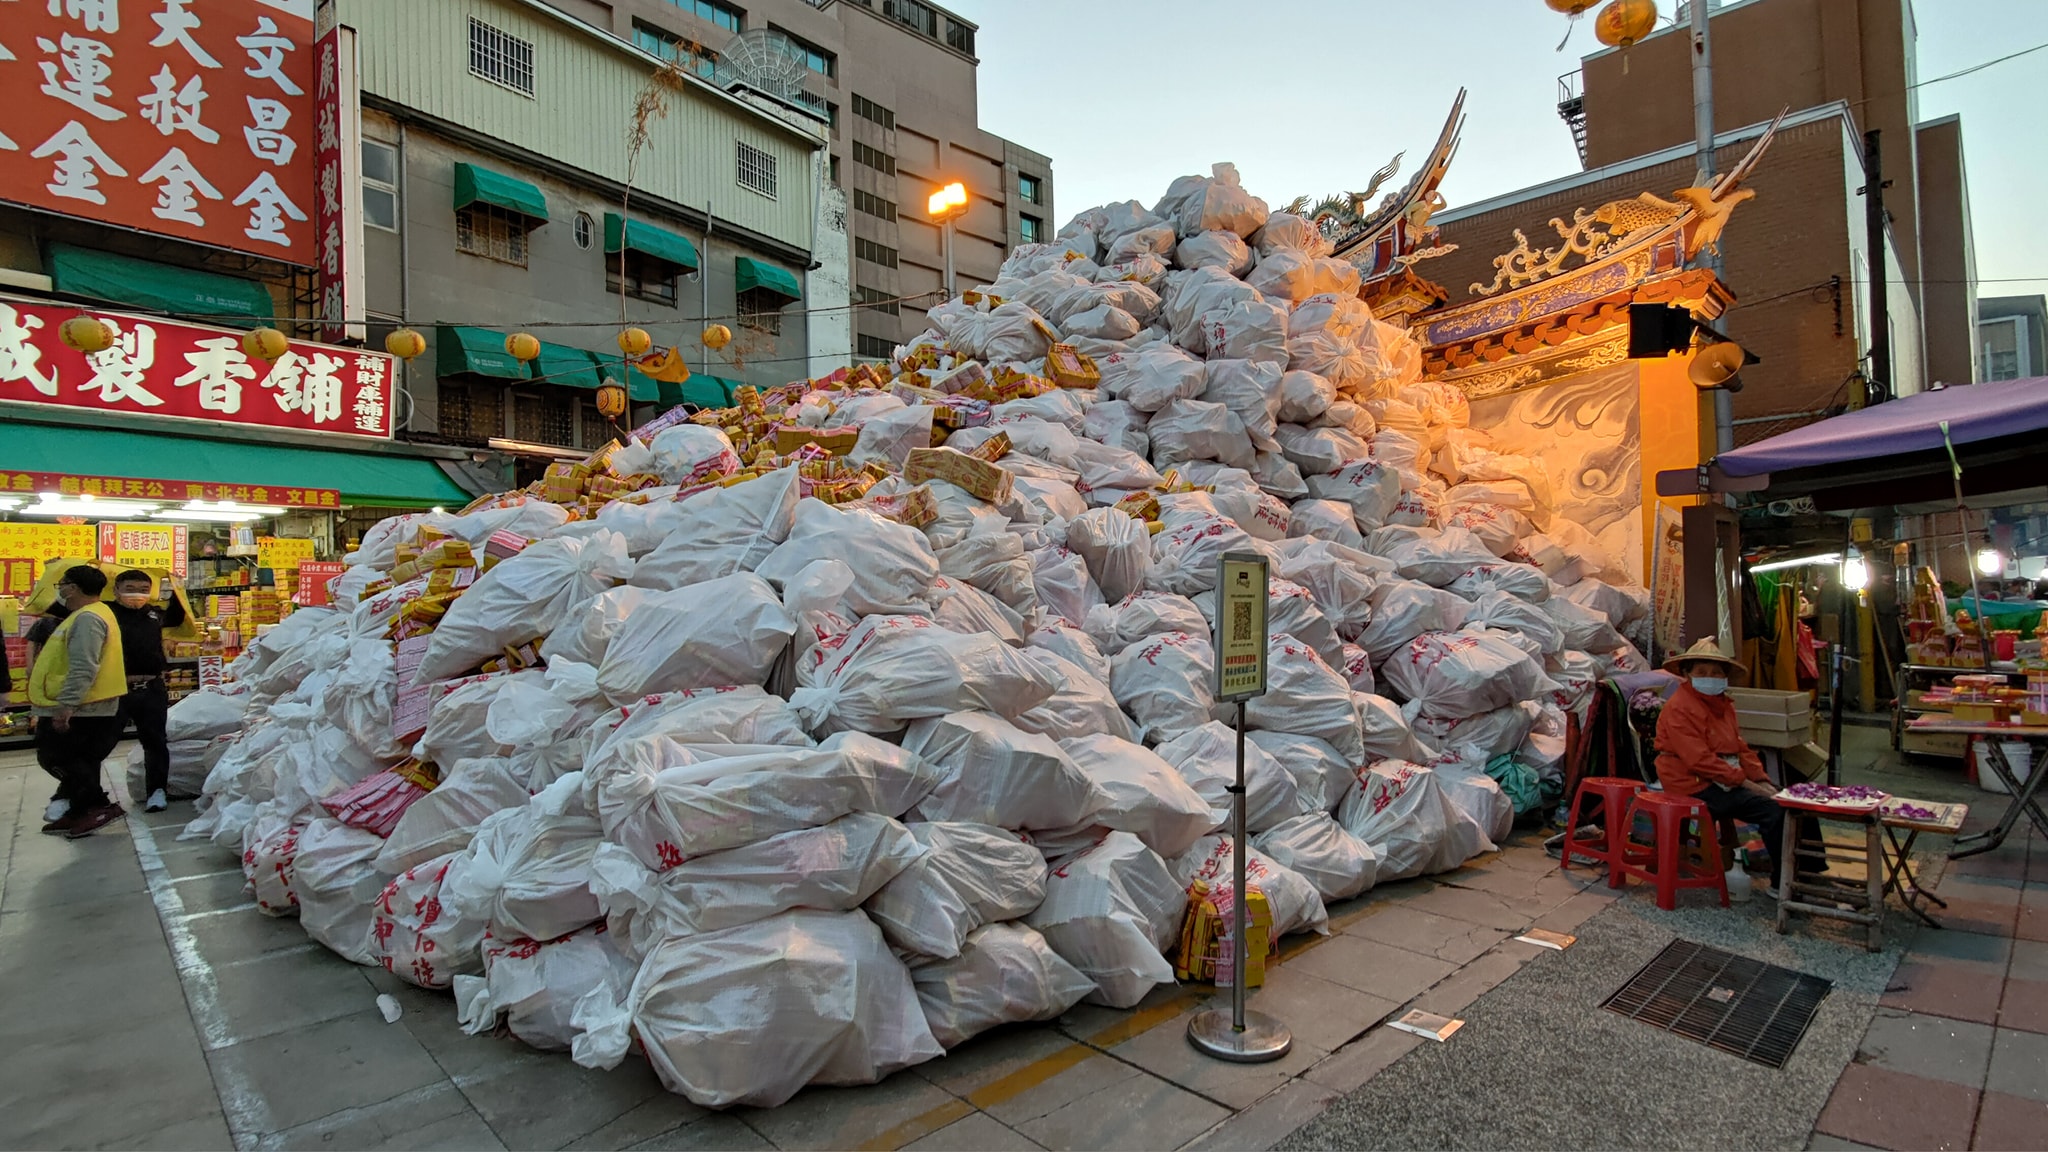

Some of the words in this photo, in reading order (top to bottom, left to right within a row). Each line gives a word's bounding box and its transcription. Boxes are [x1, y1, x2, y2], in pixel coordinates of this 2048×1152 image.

[138, 0, 224, 227] 天赦金
[232, 16, 308, 247] 文昌金
[352, 354, 387, 433] 補財庫補運
[59, 476, 165, 497] 結婚拜天公
[287, 489, 335, 506] 文昌金
